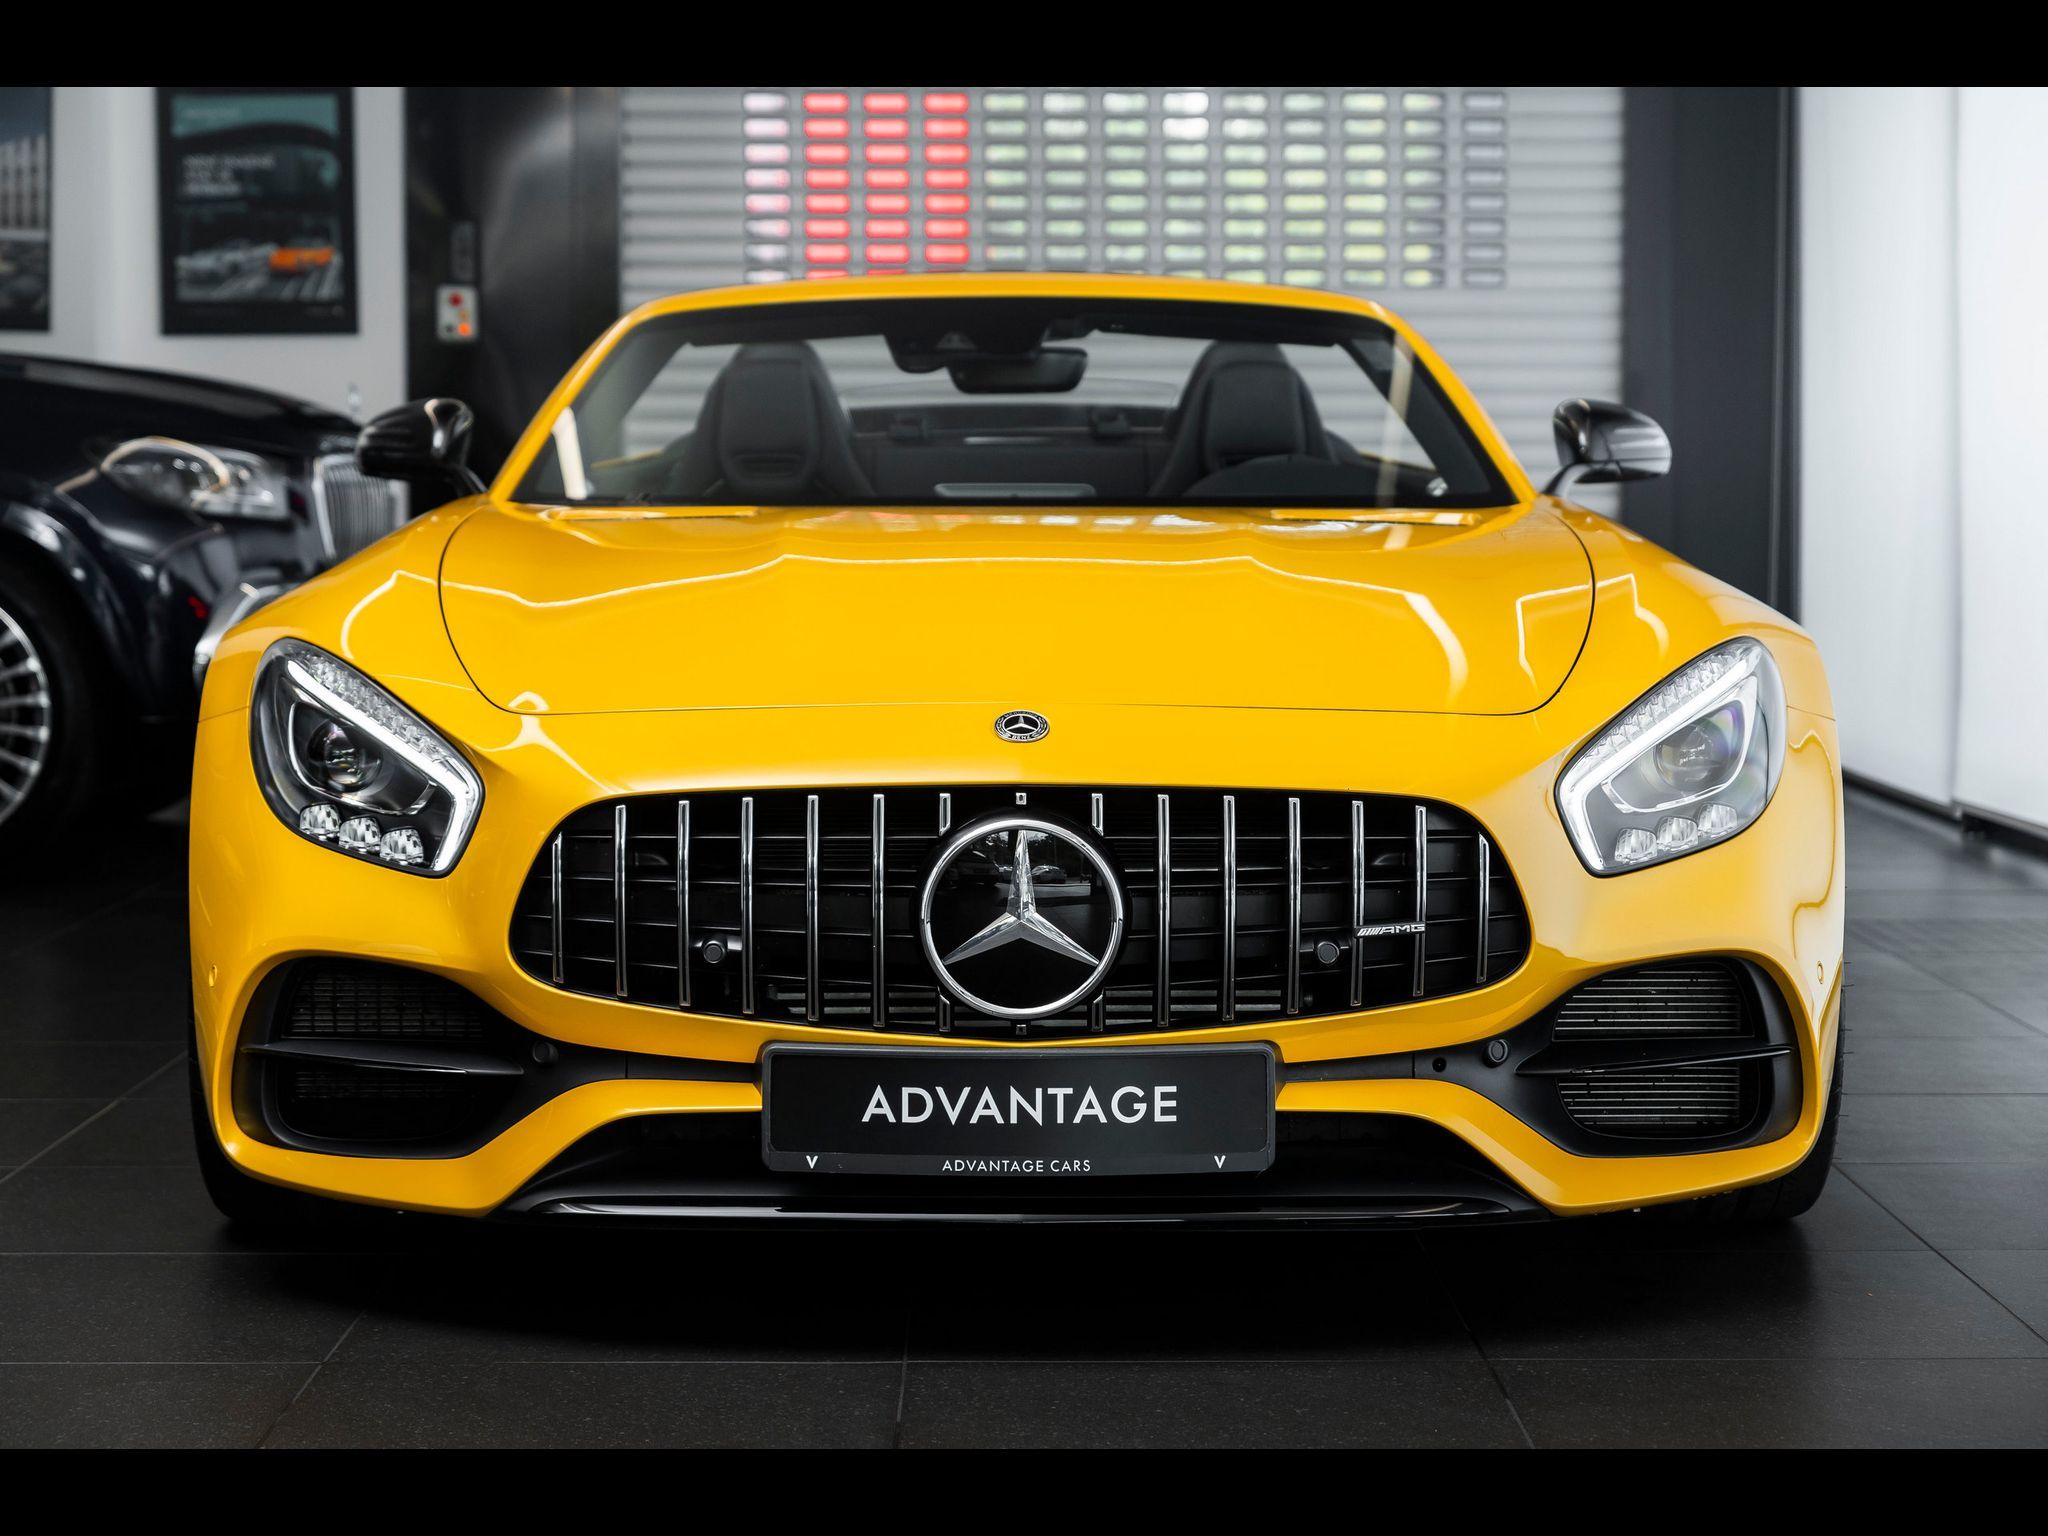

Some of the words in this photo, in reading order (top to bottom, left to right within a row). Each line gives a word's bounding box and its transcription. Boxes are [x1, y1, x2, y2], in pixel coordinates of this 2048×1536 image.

[862, 1085, 1178, 1126] ADVANTAGE
[941, 1159, 1044, 1173] ADVANTAGE
[1050, 1159, 1091, 1173] CARS
